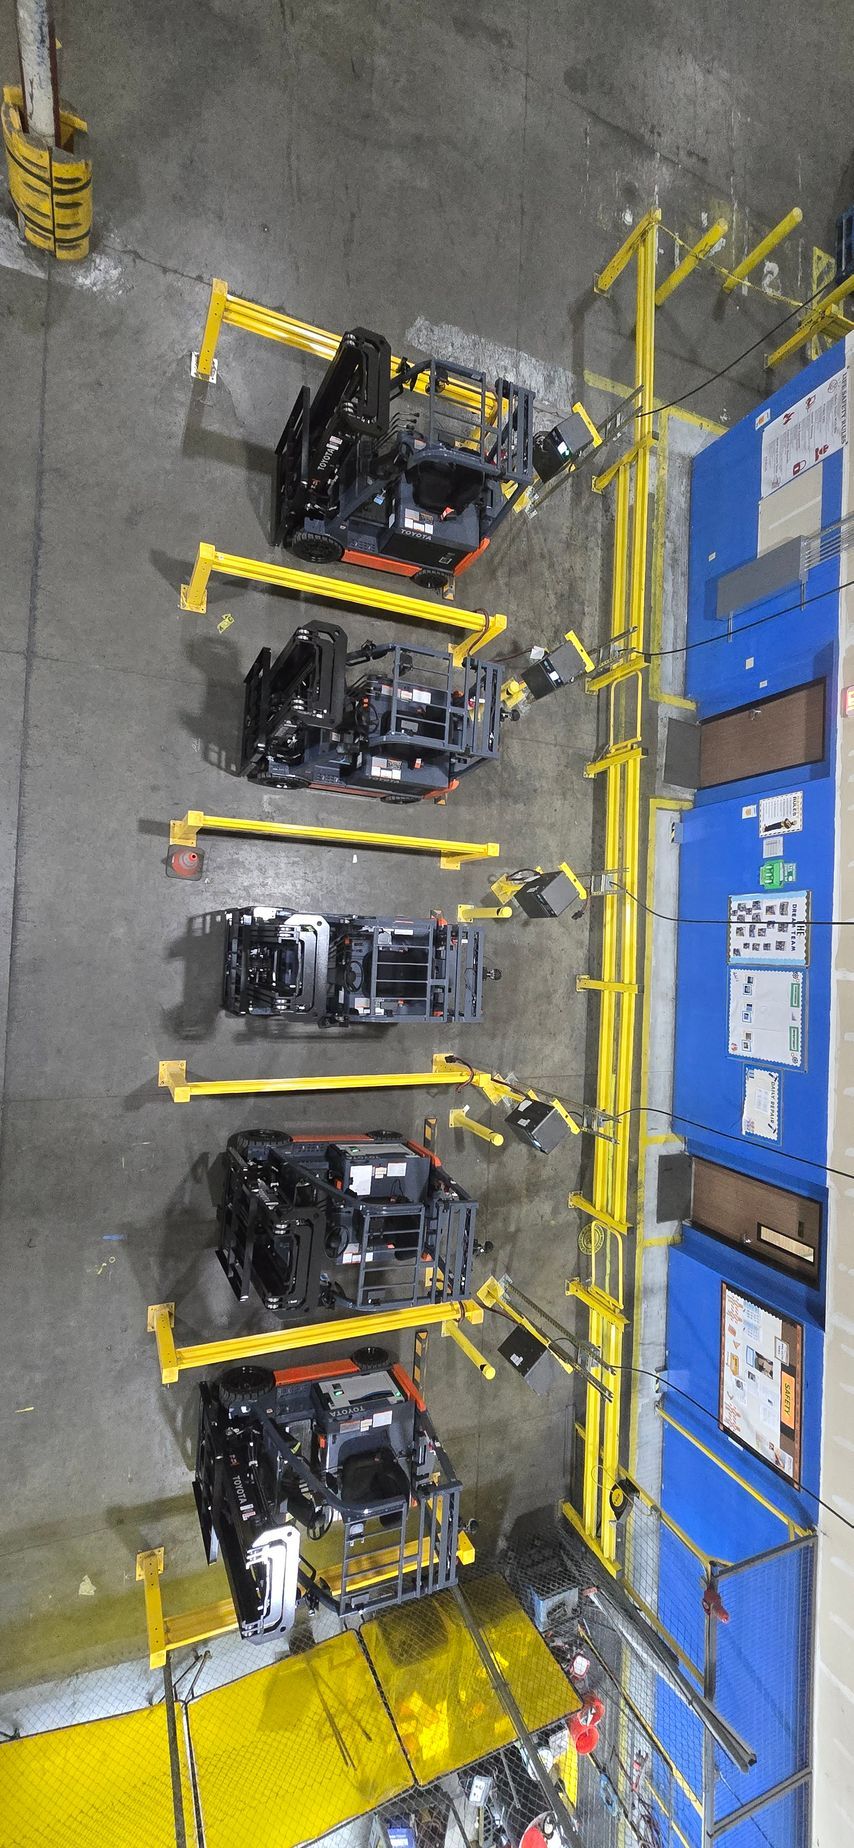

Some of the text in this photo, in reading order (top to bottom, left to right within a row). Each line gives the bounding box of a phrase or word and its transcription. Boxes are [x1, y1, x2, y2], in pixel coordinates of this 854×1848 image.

[317, 447, 335, 471] TOYOTA
[400, 528, 433, 541] TOYOTA
[329, 1405, 364, 1417] TOYOTA
[232, 1475, 246, 1508] TOYOTA
